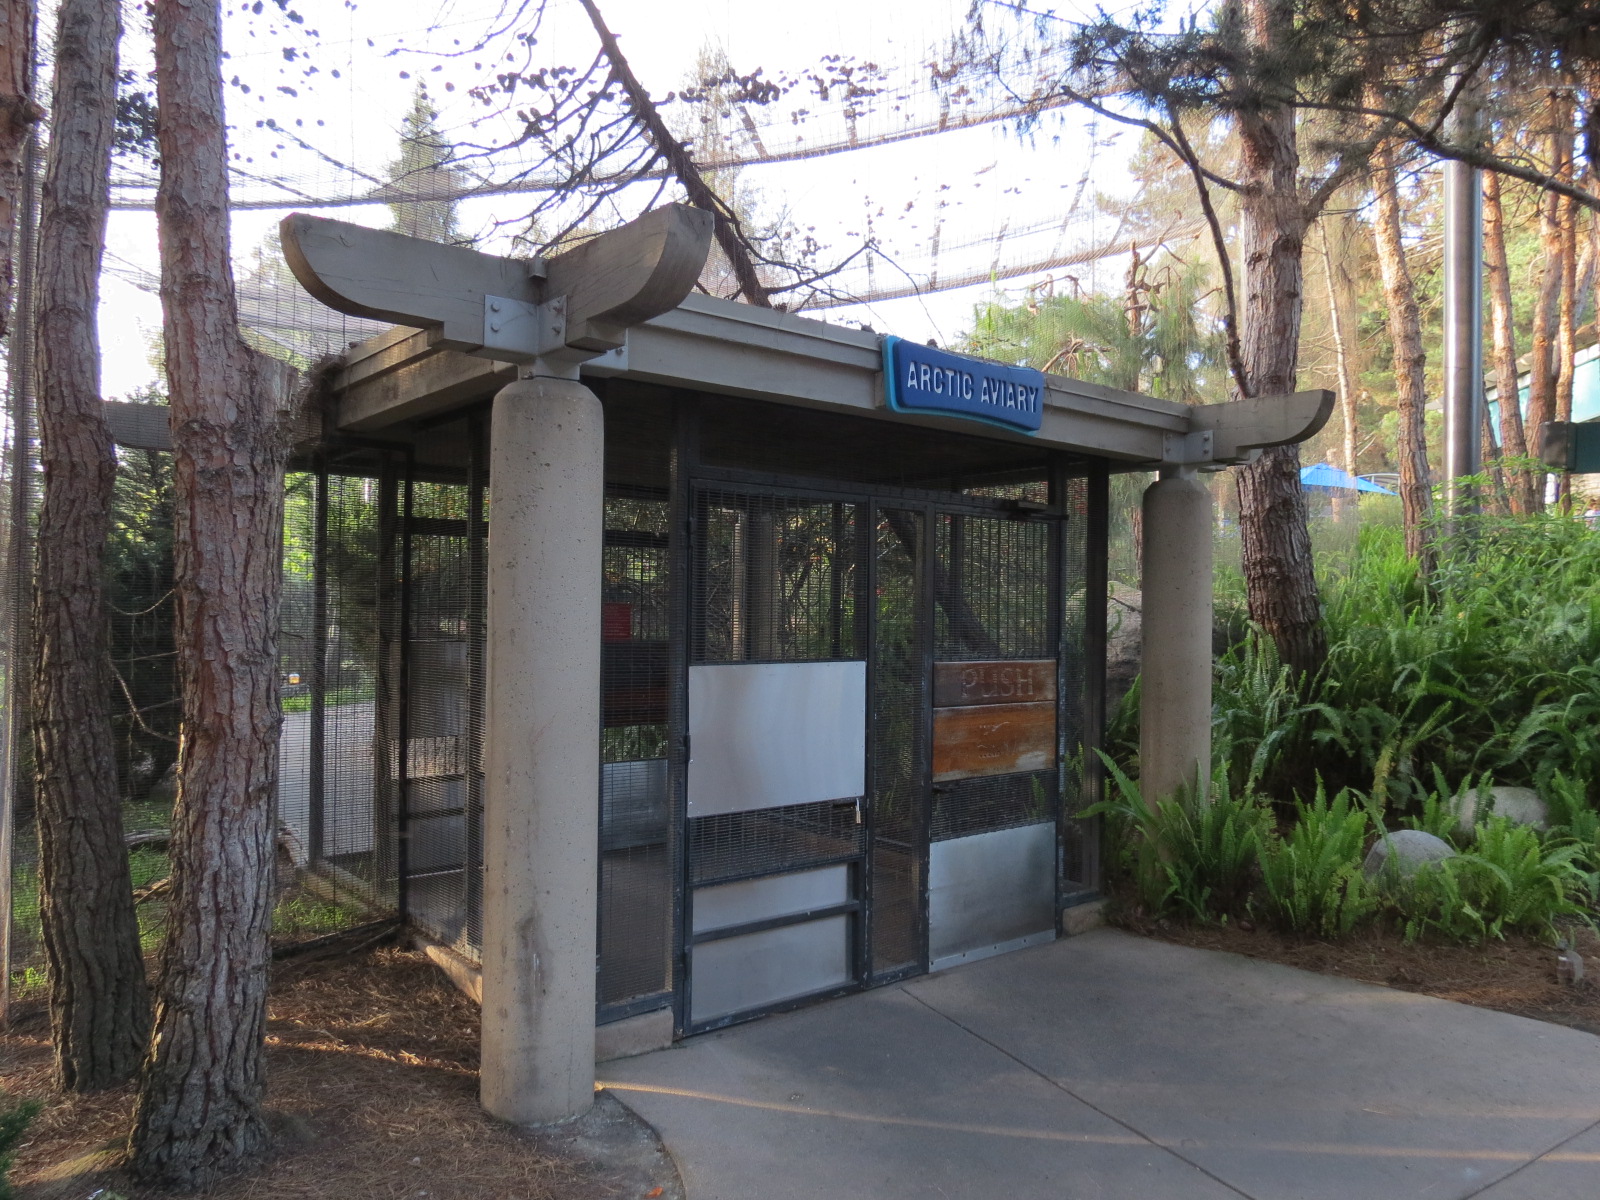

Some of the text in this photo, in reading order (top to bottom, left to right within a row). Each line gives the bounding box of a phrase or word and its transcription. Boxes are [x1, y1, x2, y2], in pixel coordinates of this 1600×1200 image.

[907, 361, 1039, 413] ARCTIC AVIARY
[961, 667, 1035, 698] PUSH
